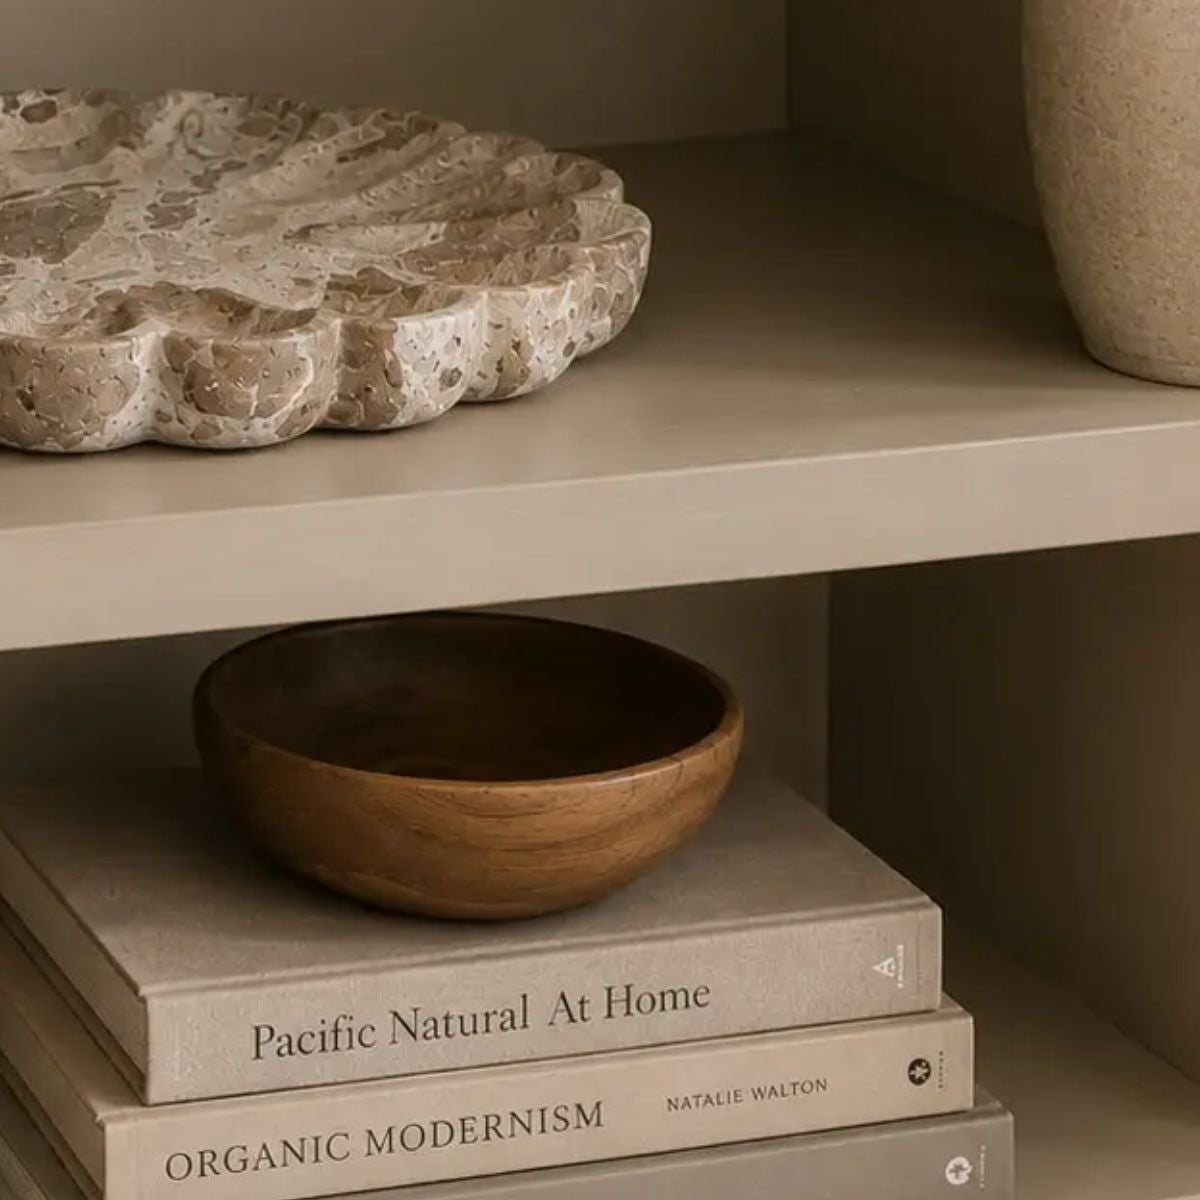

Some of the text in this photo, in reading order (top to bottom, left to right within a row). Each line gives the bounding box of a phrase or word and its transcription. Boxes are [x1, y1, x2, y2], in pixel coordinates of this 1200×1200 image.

[253, 984, 710, 1060] Pacific Natural At Home
[667, 1079, 827, 1112] NATALIE WALTON
[166, 1101, 603, 1180] ORGANIC MODERNISM
